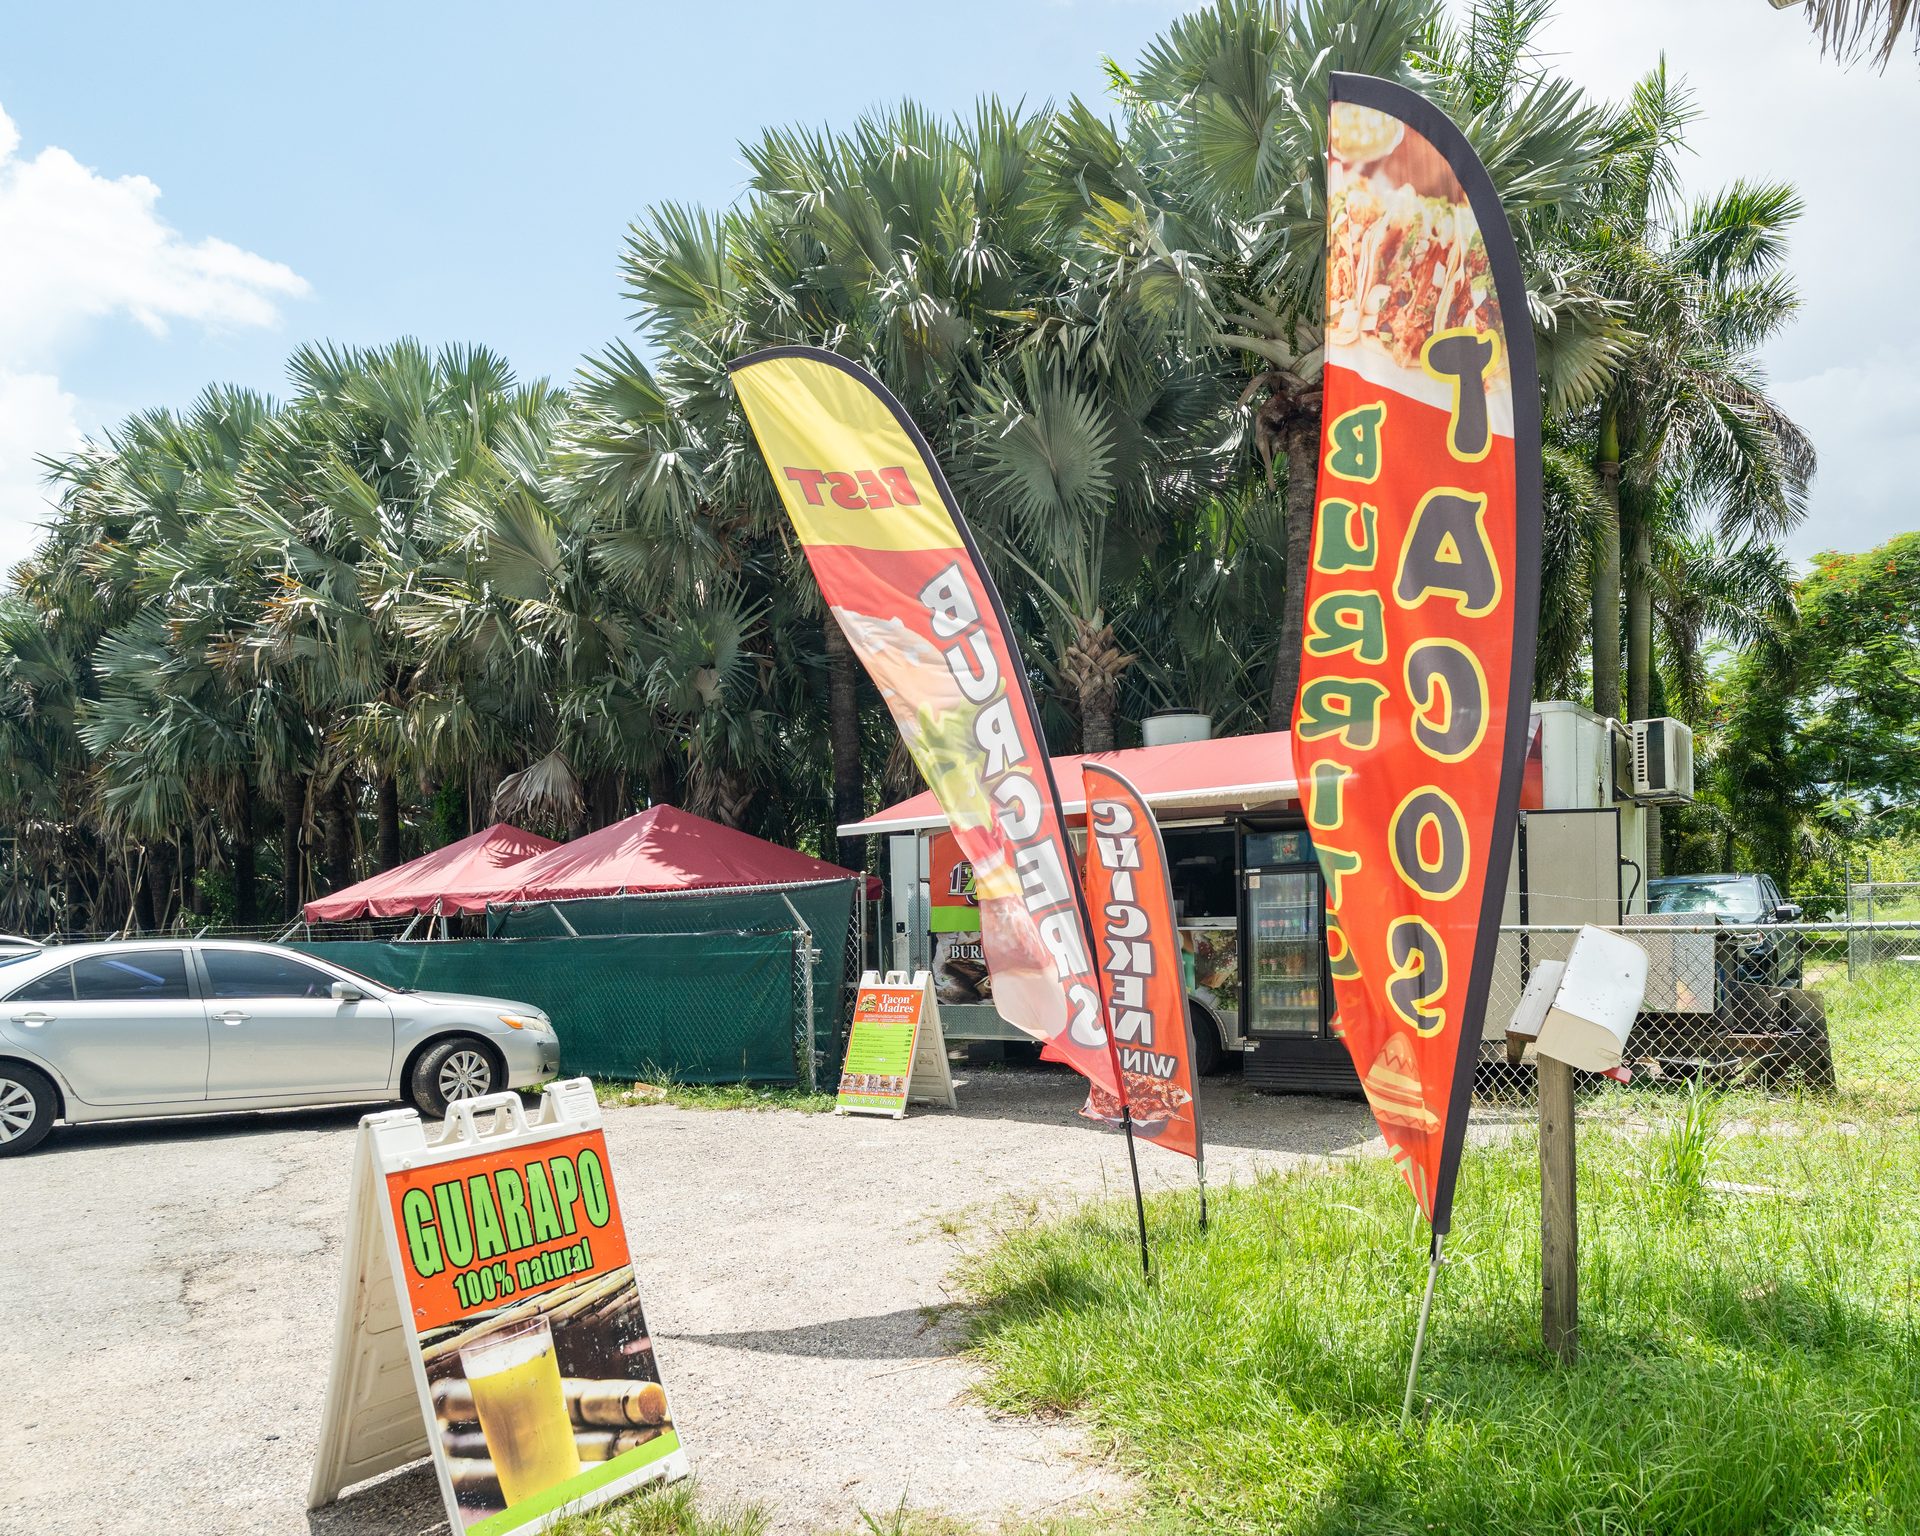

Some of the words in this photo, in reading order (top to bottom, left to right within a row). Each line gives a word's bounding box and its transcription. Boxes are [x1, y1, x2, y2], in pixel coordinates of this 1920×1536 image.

[878, 1003, 914, 1013] Madres
[402, 1148, 610, 1278] GUARAPO
[453, 1260, 515, 1309] 100%
[516, 1237, 594, 1290] natural
